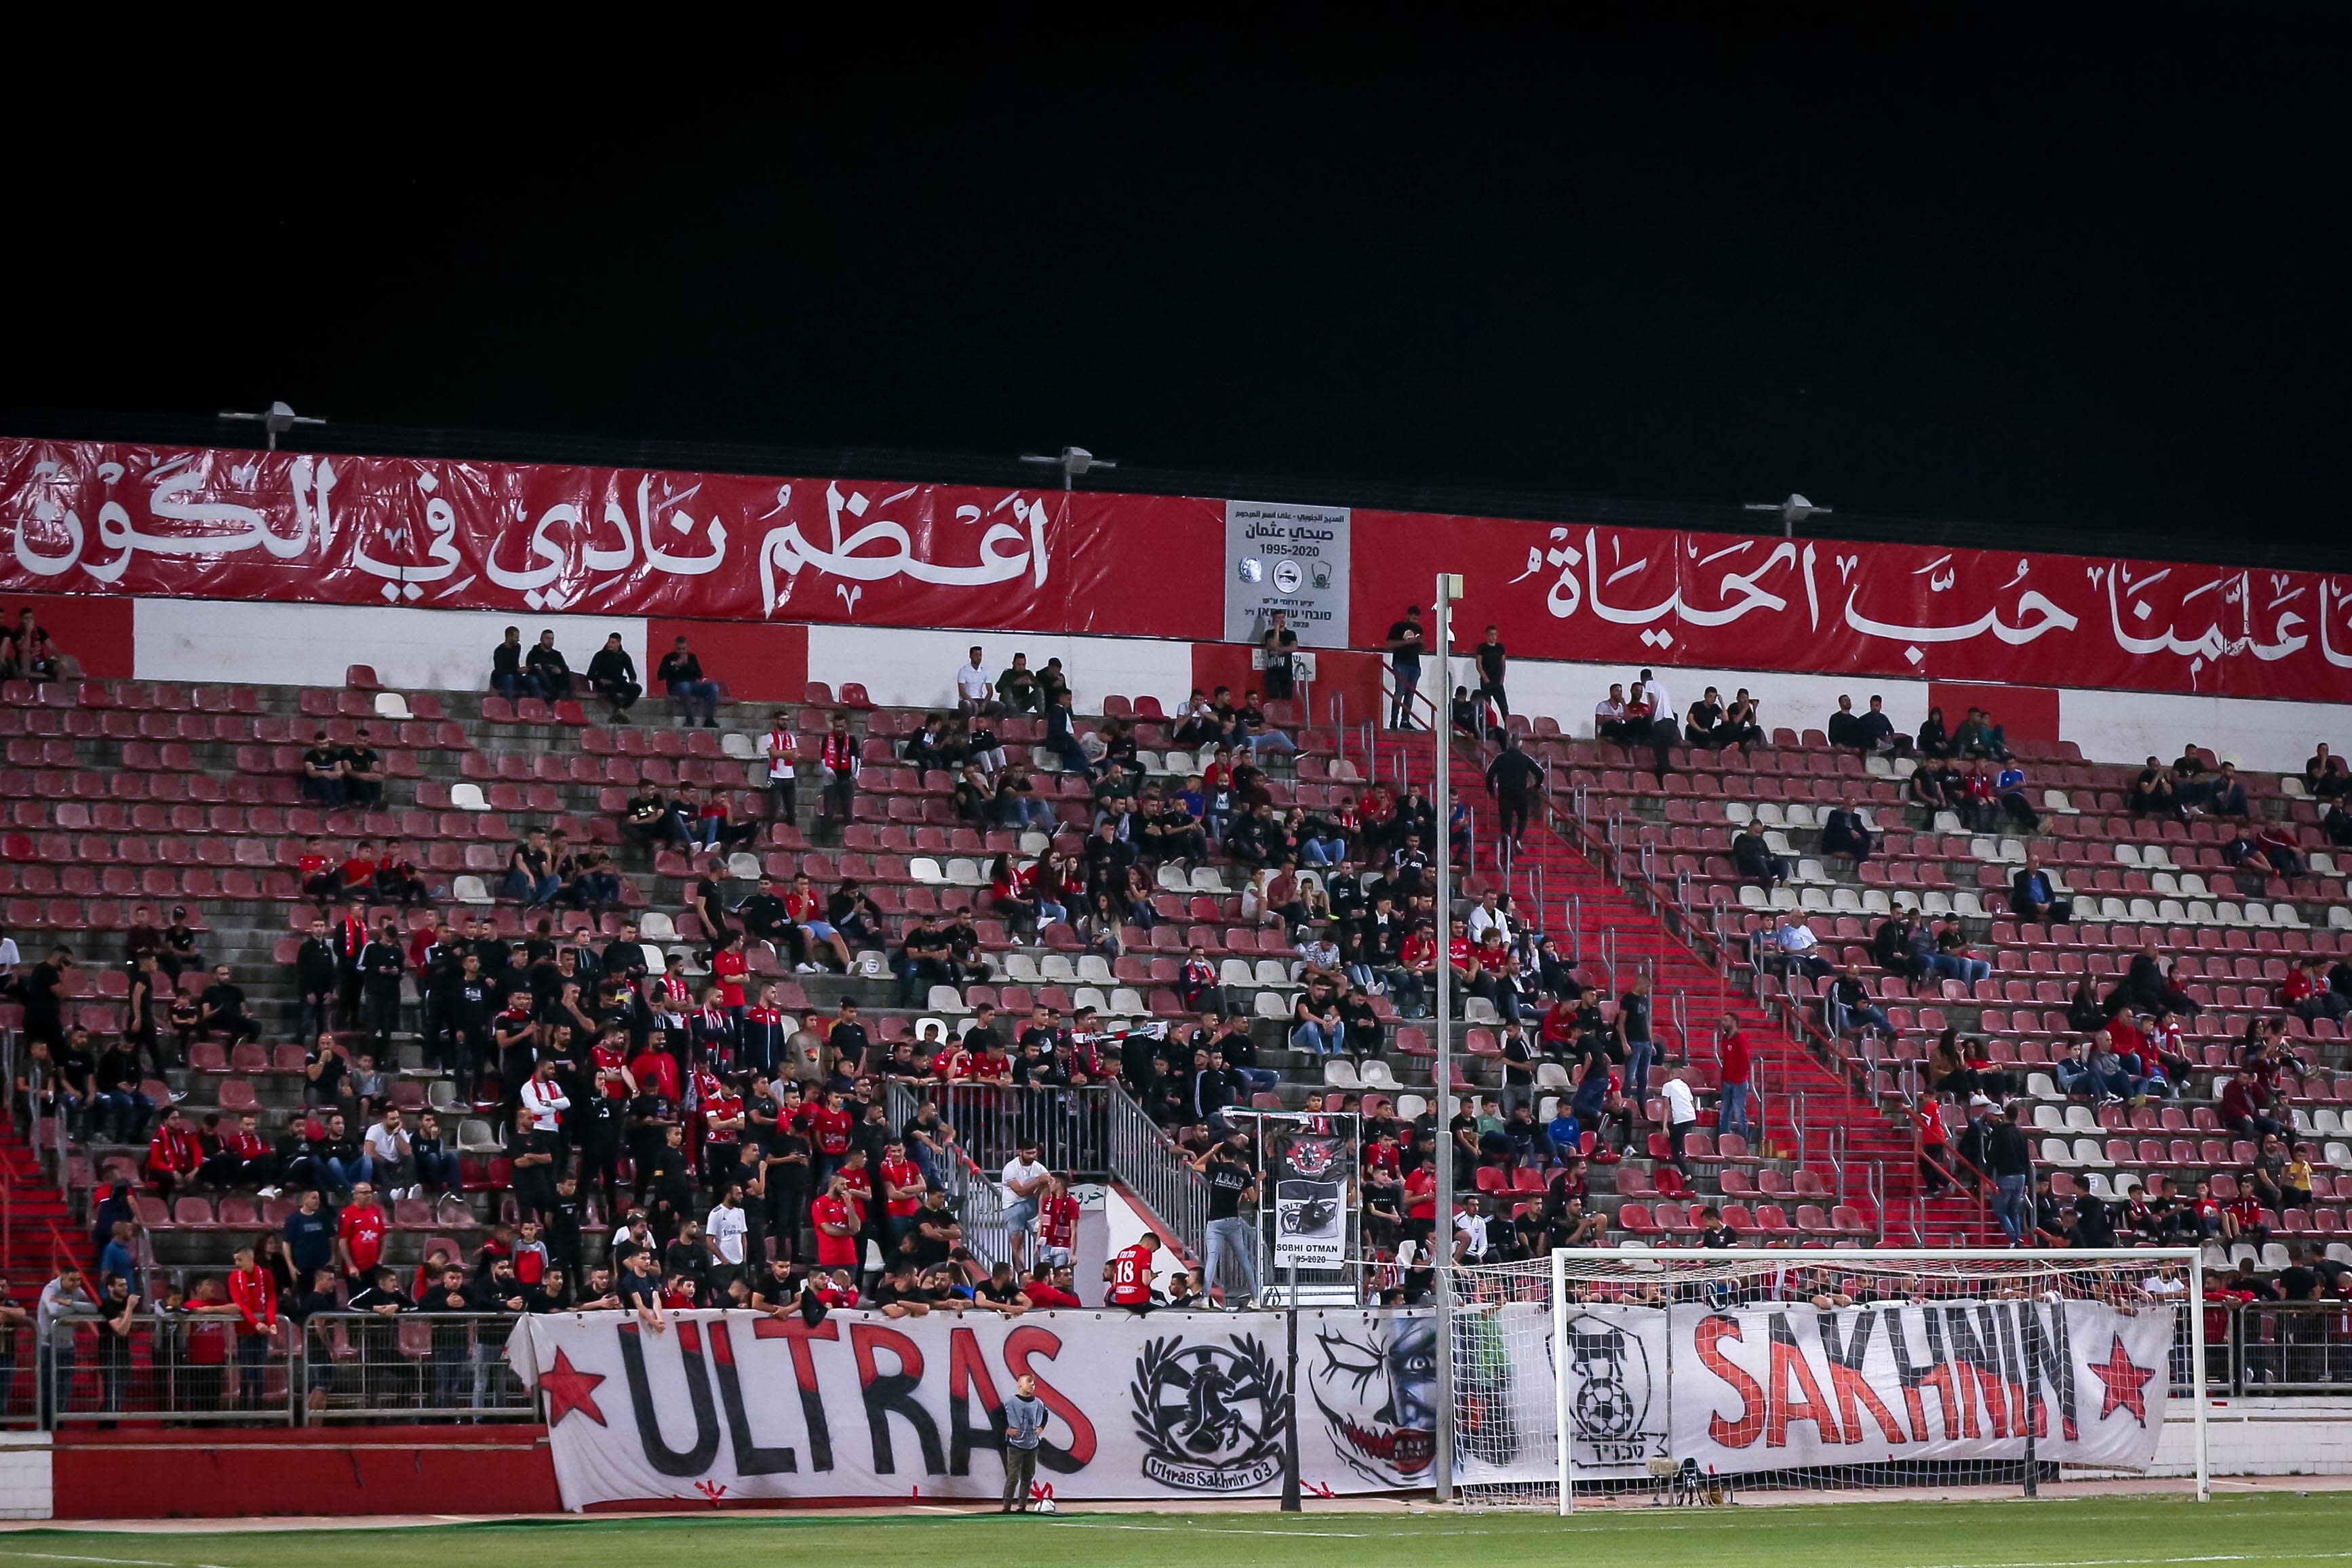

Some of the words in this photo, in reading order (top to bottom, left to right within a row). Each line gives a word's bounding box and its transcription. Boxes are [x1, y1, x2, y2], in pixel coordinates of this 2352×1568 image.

[1245, 520, 1285, 540] عثمان
[1289, 526, 1334, 543] صبحي
[1259, 543, 1320, 557] 1995-2020
[1301, 609, 1332, 621] סובחי
[1276, 1243, 1303, 1252] SOBHI
[1306, 1244, 1338, 1253] OTMAN
[1287, 1255, 1326, 1263] 195-2020
[1117, 1260, 1135, 1283] 18
[1695, 1300, 2079, 1449] SAKHNIN
[618, 1317, 1097, 1477] ULTRAS
[1152, 1459, 1195, 1485] Ultras
[1197, 1471, 1250, 1489] Sakhnin
[1253, 1462, 1272, 1482] 03
